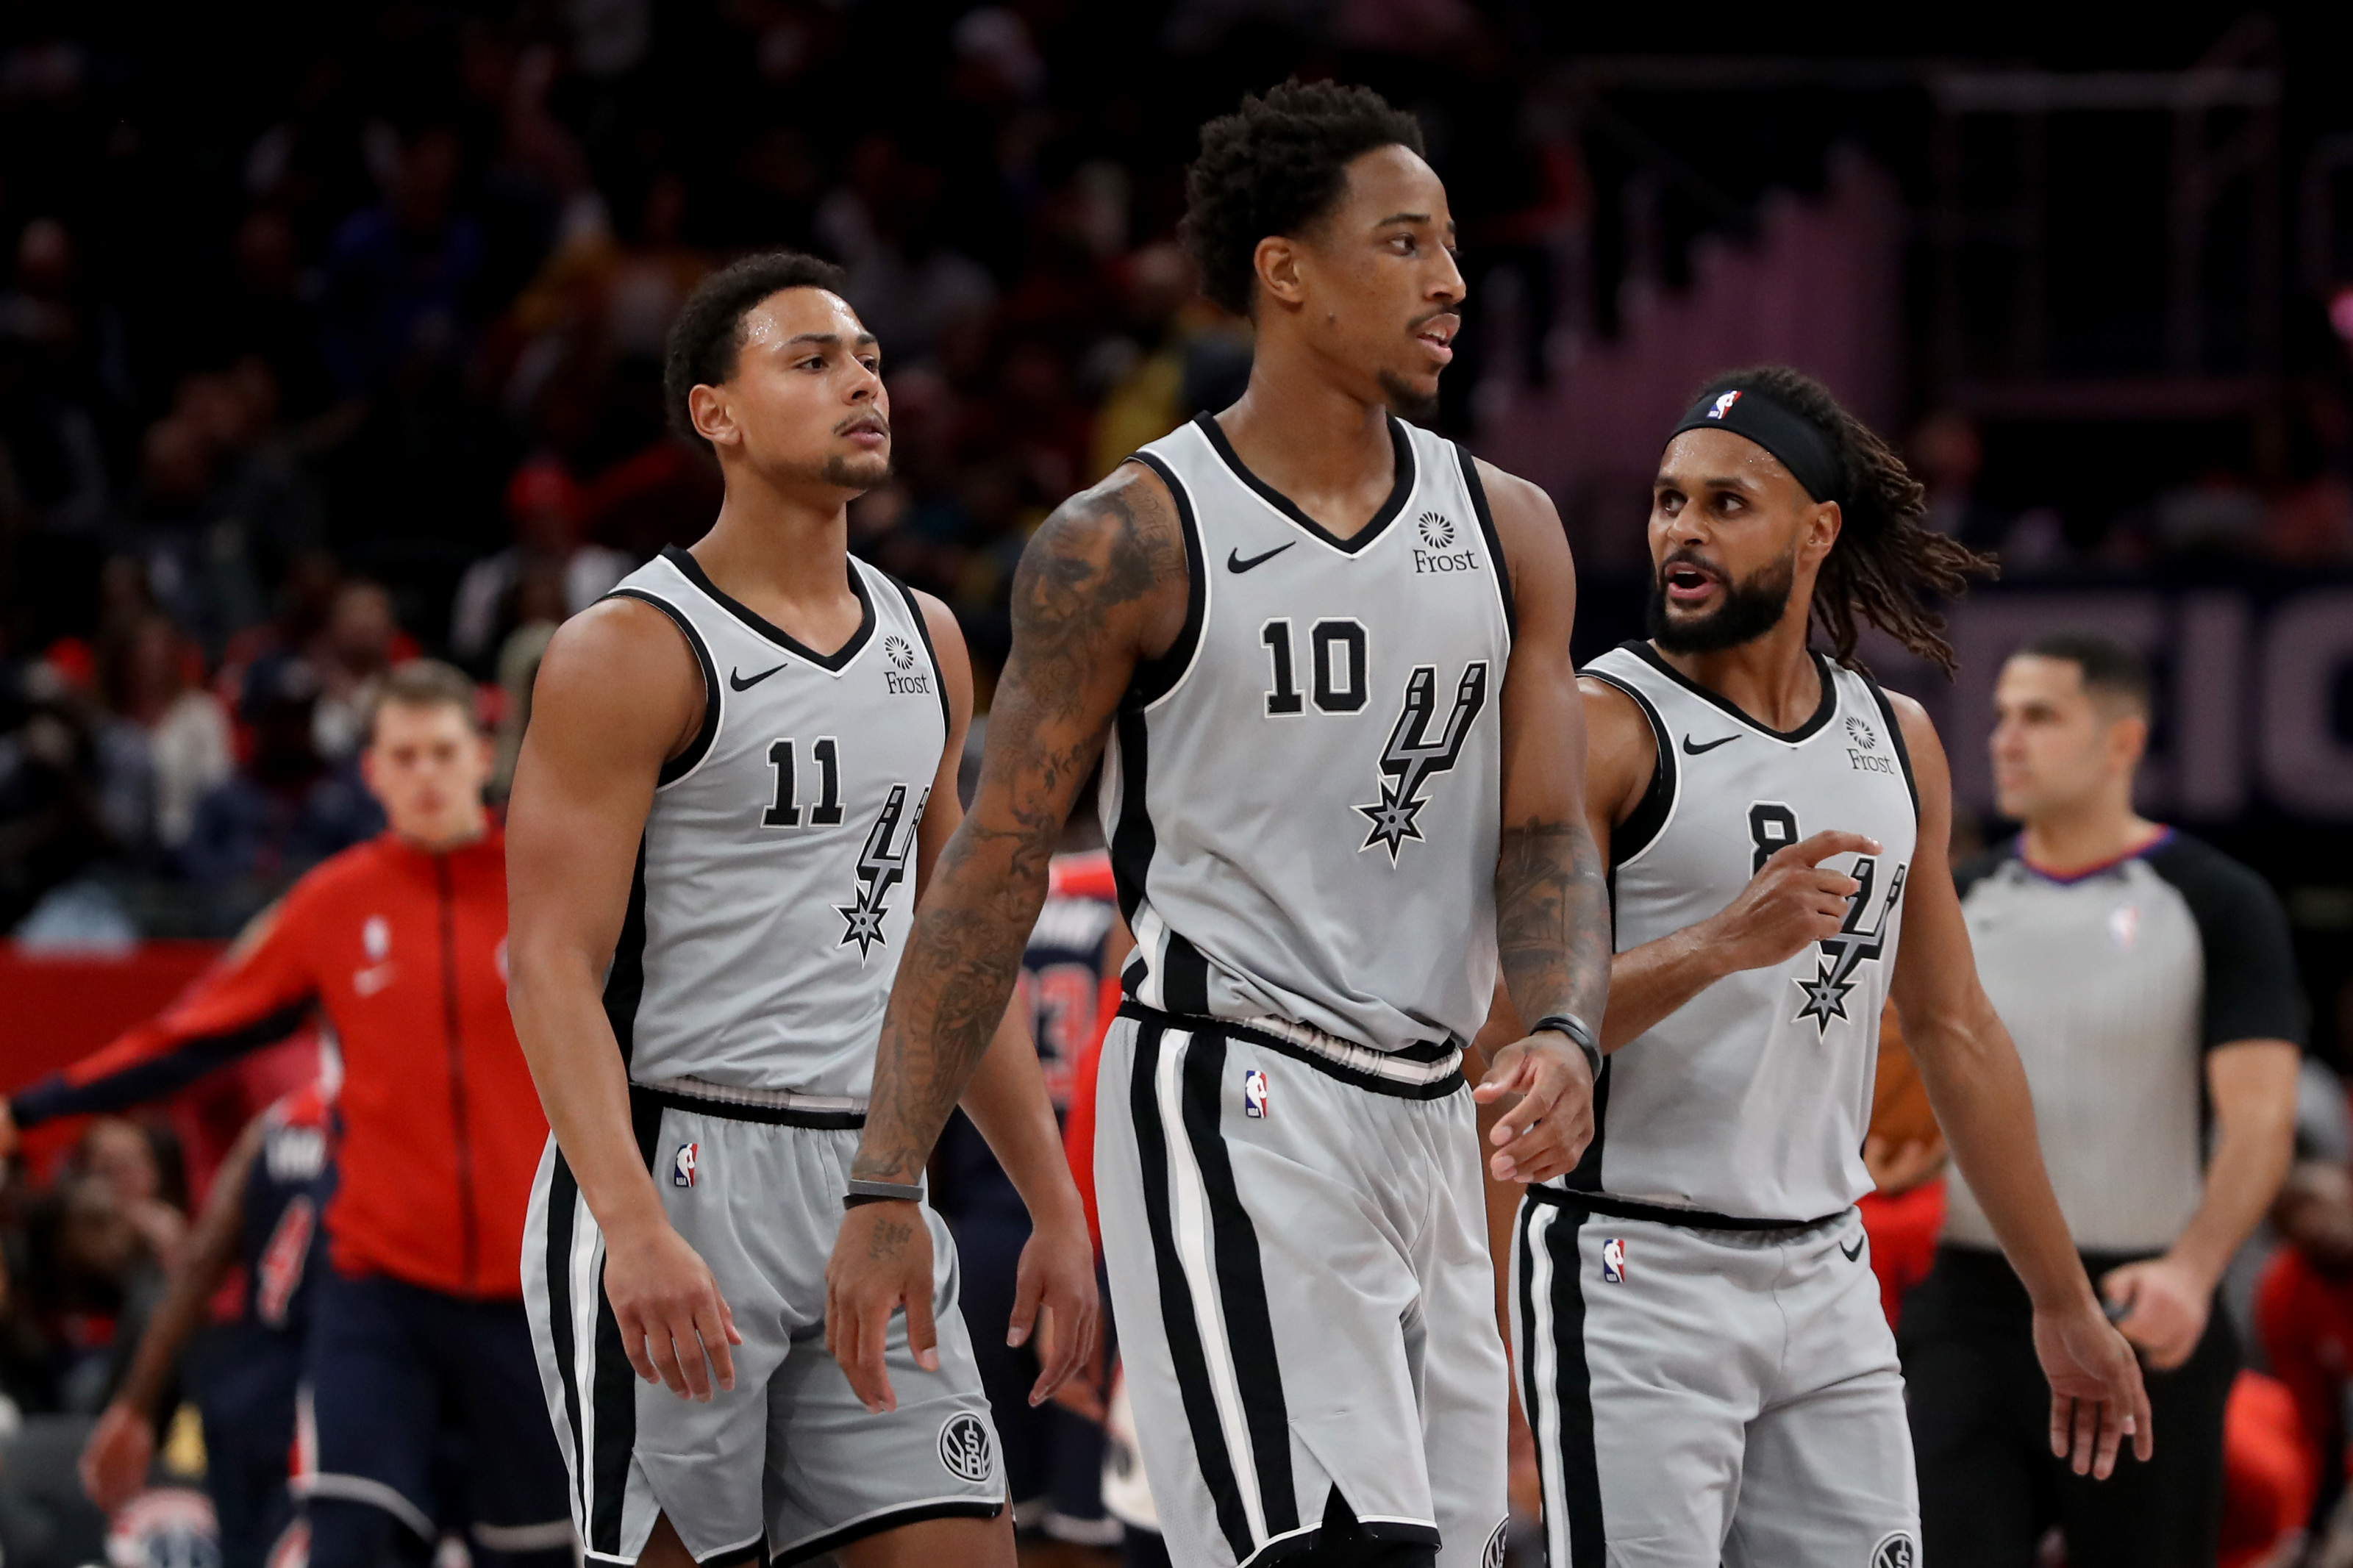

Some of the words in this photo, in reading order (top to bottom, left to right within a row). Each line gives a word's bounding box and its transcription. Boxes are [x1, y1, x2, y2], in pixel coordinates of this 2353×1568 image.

[1413, 549, 1479, 573] Frost
[884, 671, 930, 694] Frost
[1260, 616, 1371, 718] 10
[760, 735, 846, 828] 11
[1846, 748, 1895, 775] Frost
[1746, 800, 1802, 881] 8
